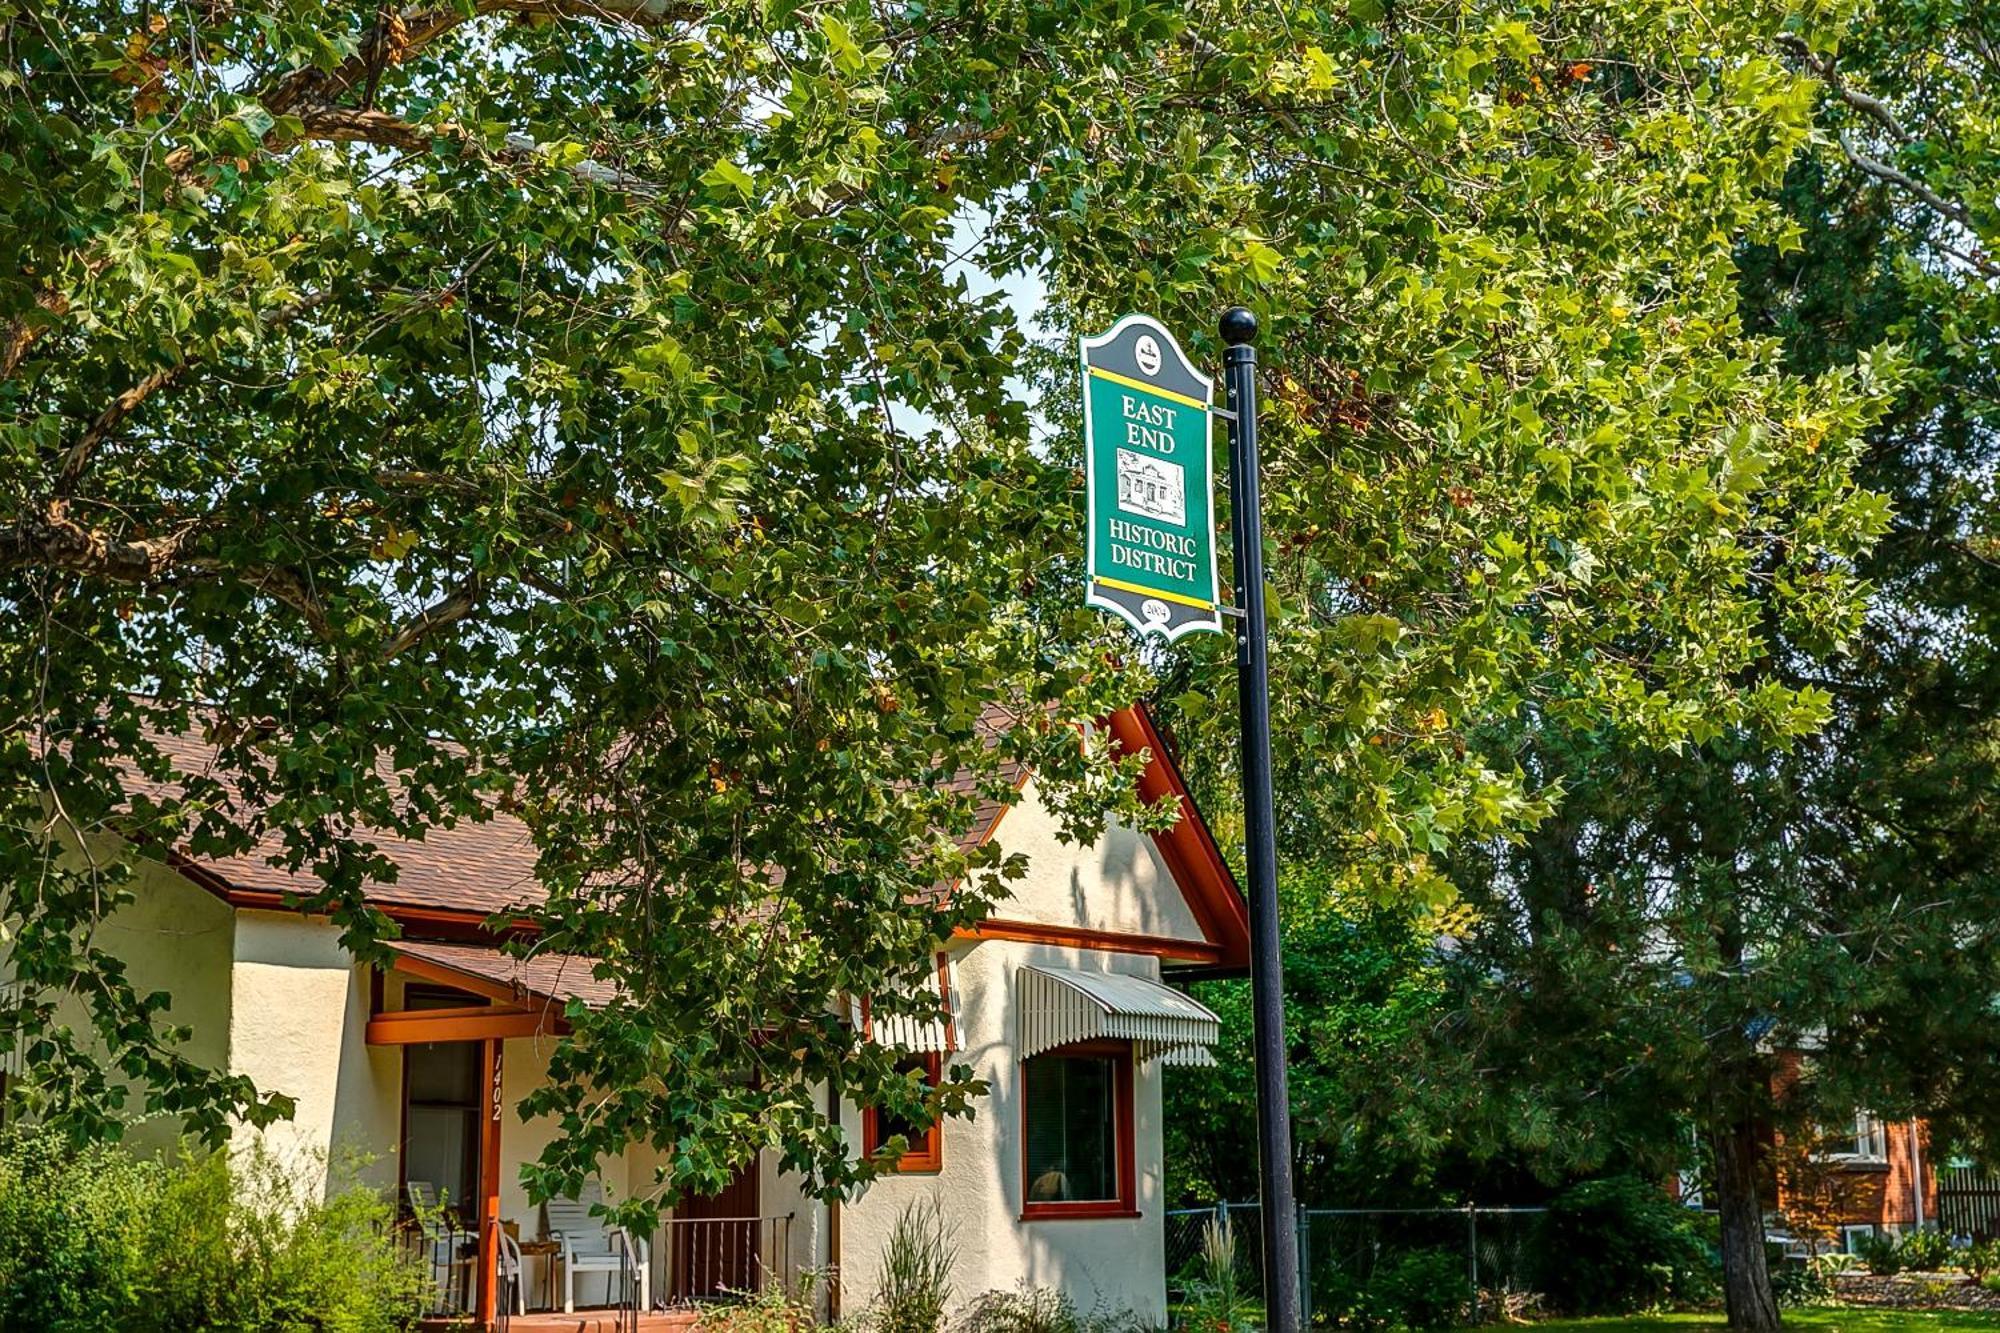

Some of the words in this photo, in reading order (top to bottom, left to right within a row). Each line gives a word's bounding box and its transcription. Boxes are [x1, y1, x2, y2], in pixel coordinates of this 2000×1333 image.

[1122, 394, 1177, 430] EAST
[1126, 422, 1176, 454] END
[1109, 518, 1197, 558] HISTORIC
[1110, 543, 1197, 582] DISTRICT
[492, 1053, 502, 1121] 1402
